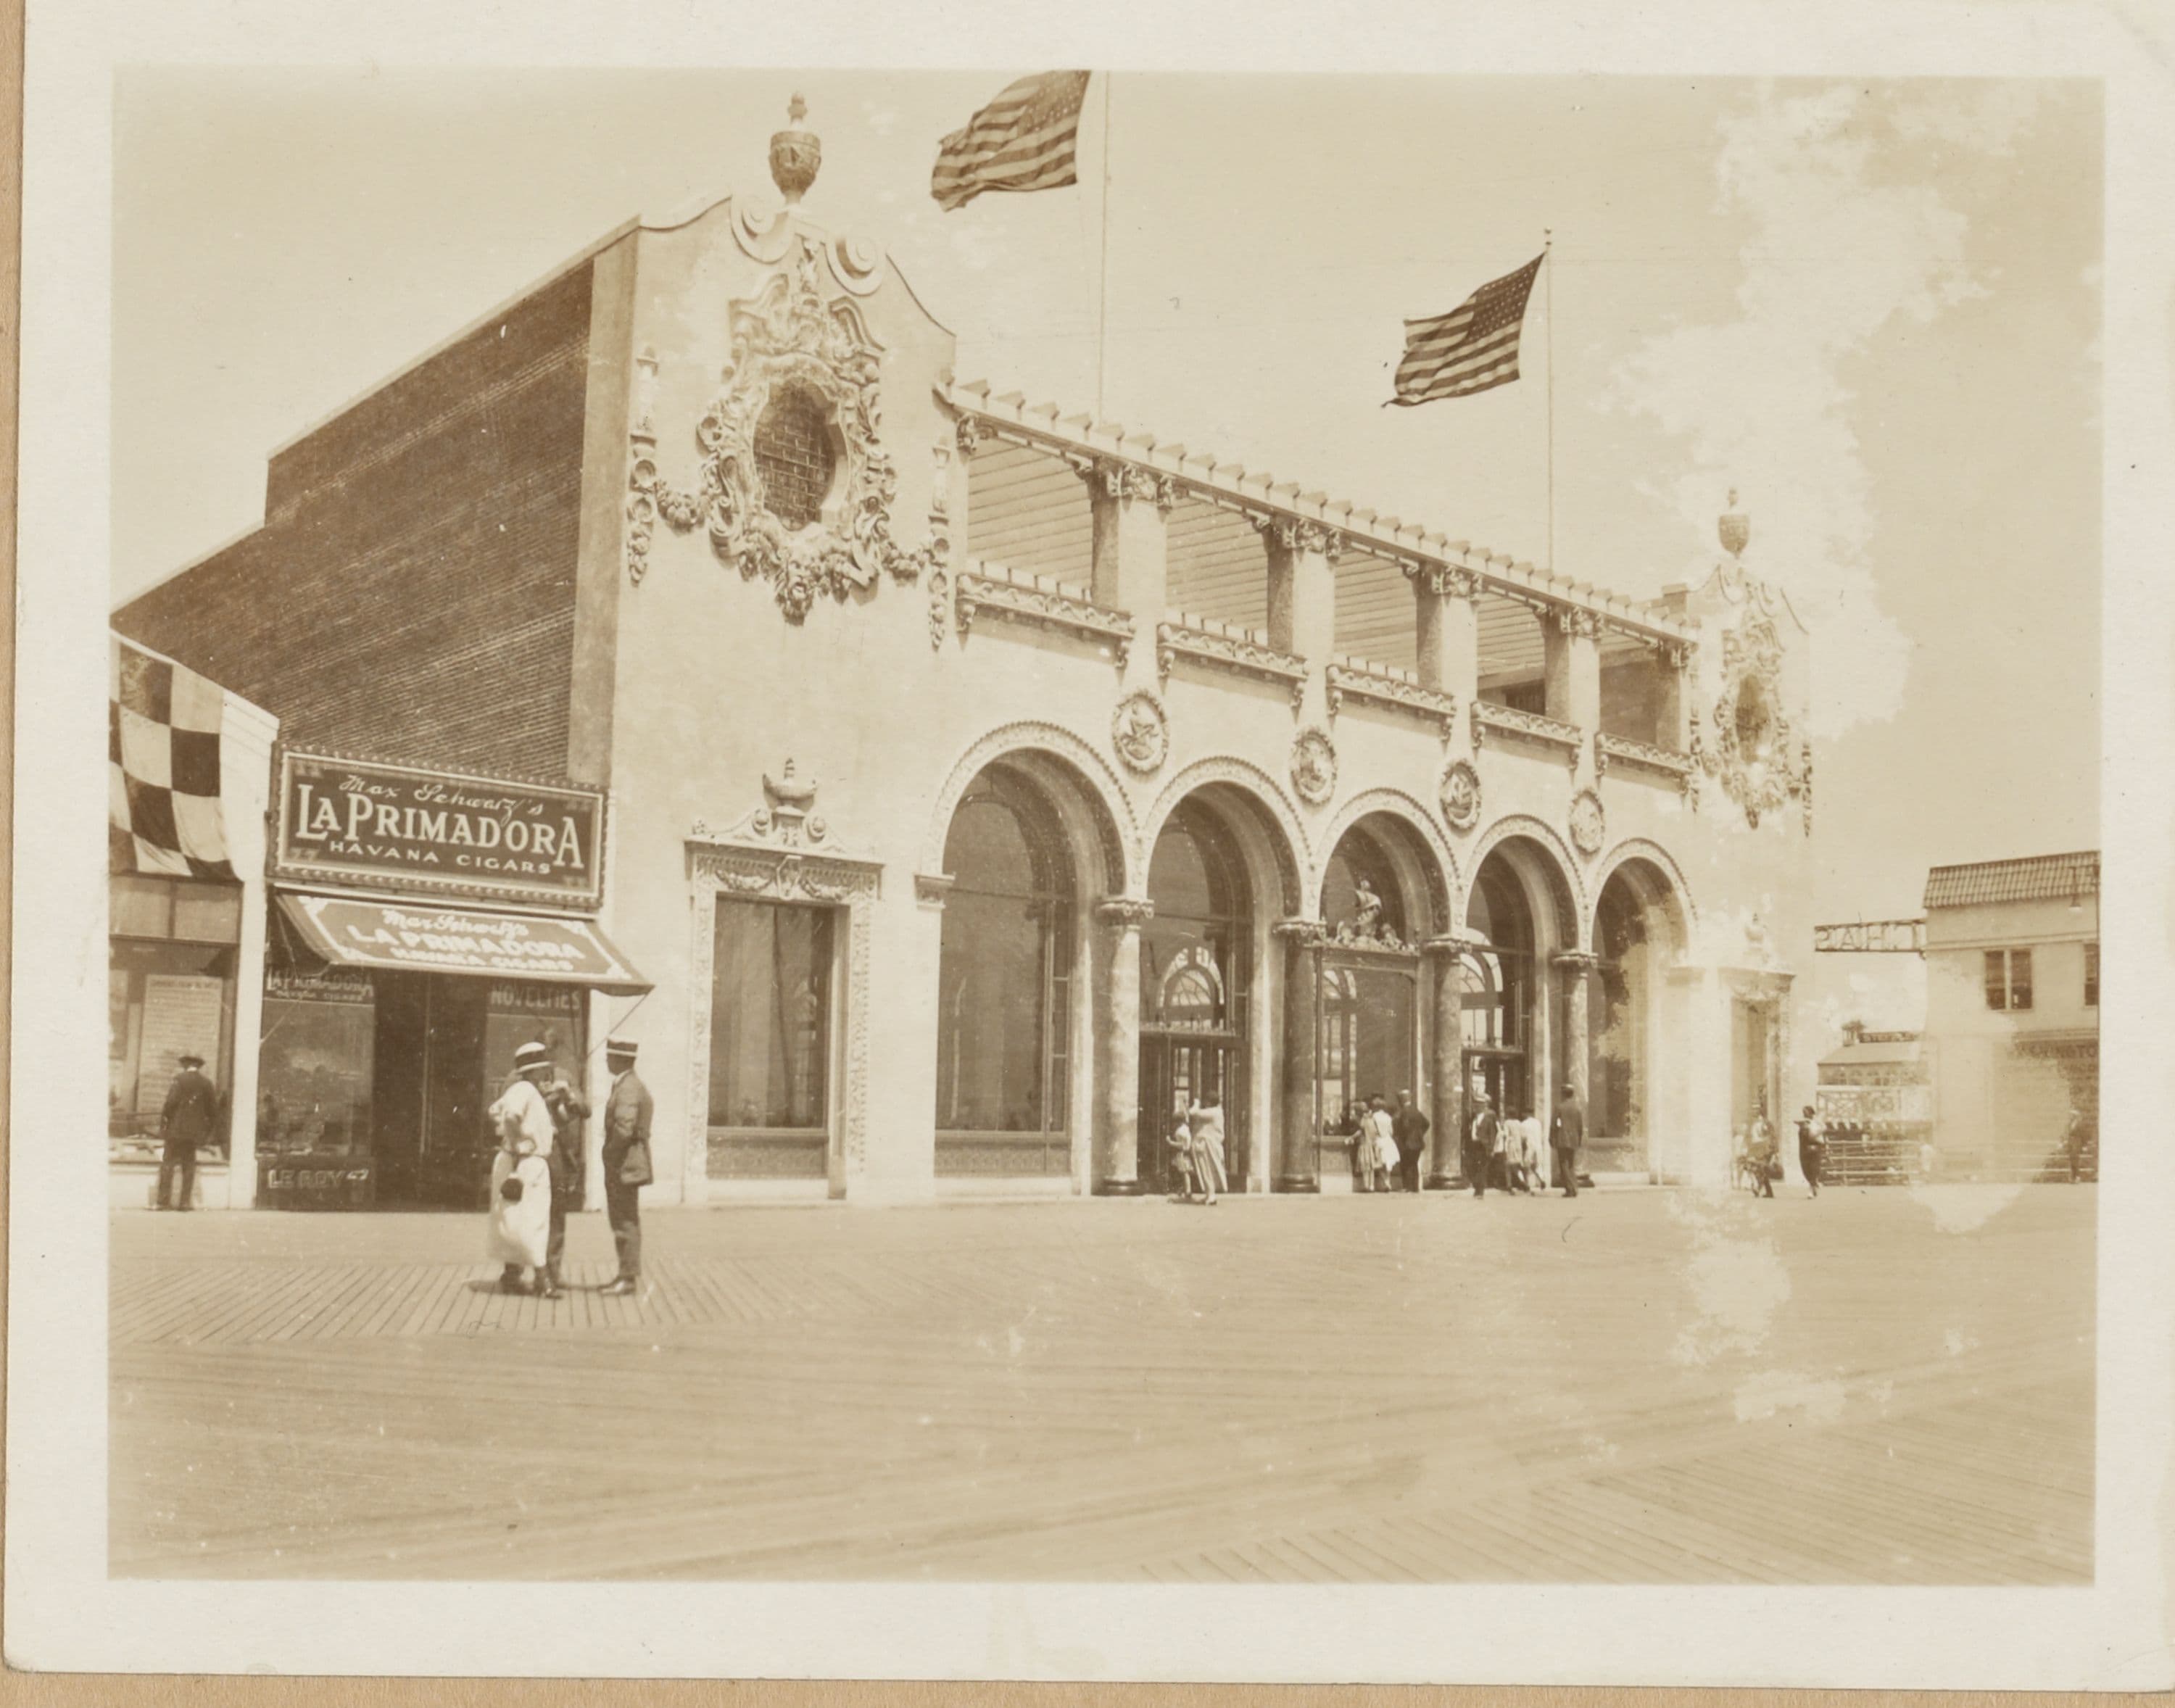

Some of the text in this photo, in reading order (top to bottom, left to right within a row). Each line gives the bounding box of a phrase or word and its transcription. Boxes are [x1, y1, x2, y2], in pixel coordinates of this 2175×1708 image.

[339, 774, 401, 798] Max
[345, 793, 585, 868] PRIMADORA
[330, 840, 551, 874] HAVANA CIGARS
[347, 925, 586, 959] LA PRIMADORA
[491, 984, 581, 1010] NOVELTIES
